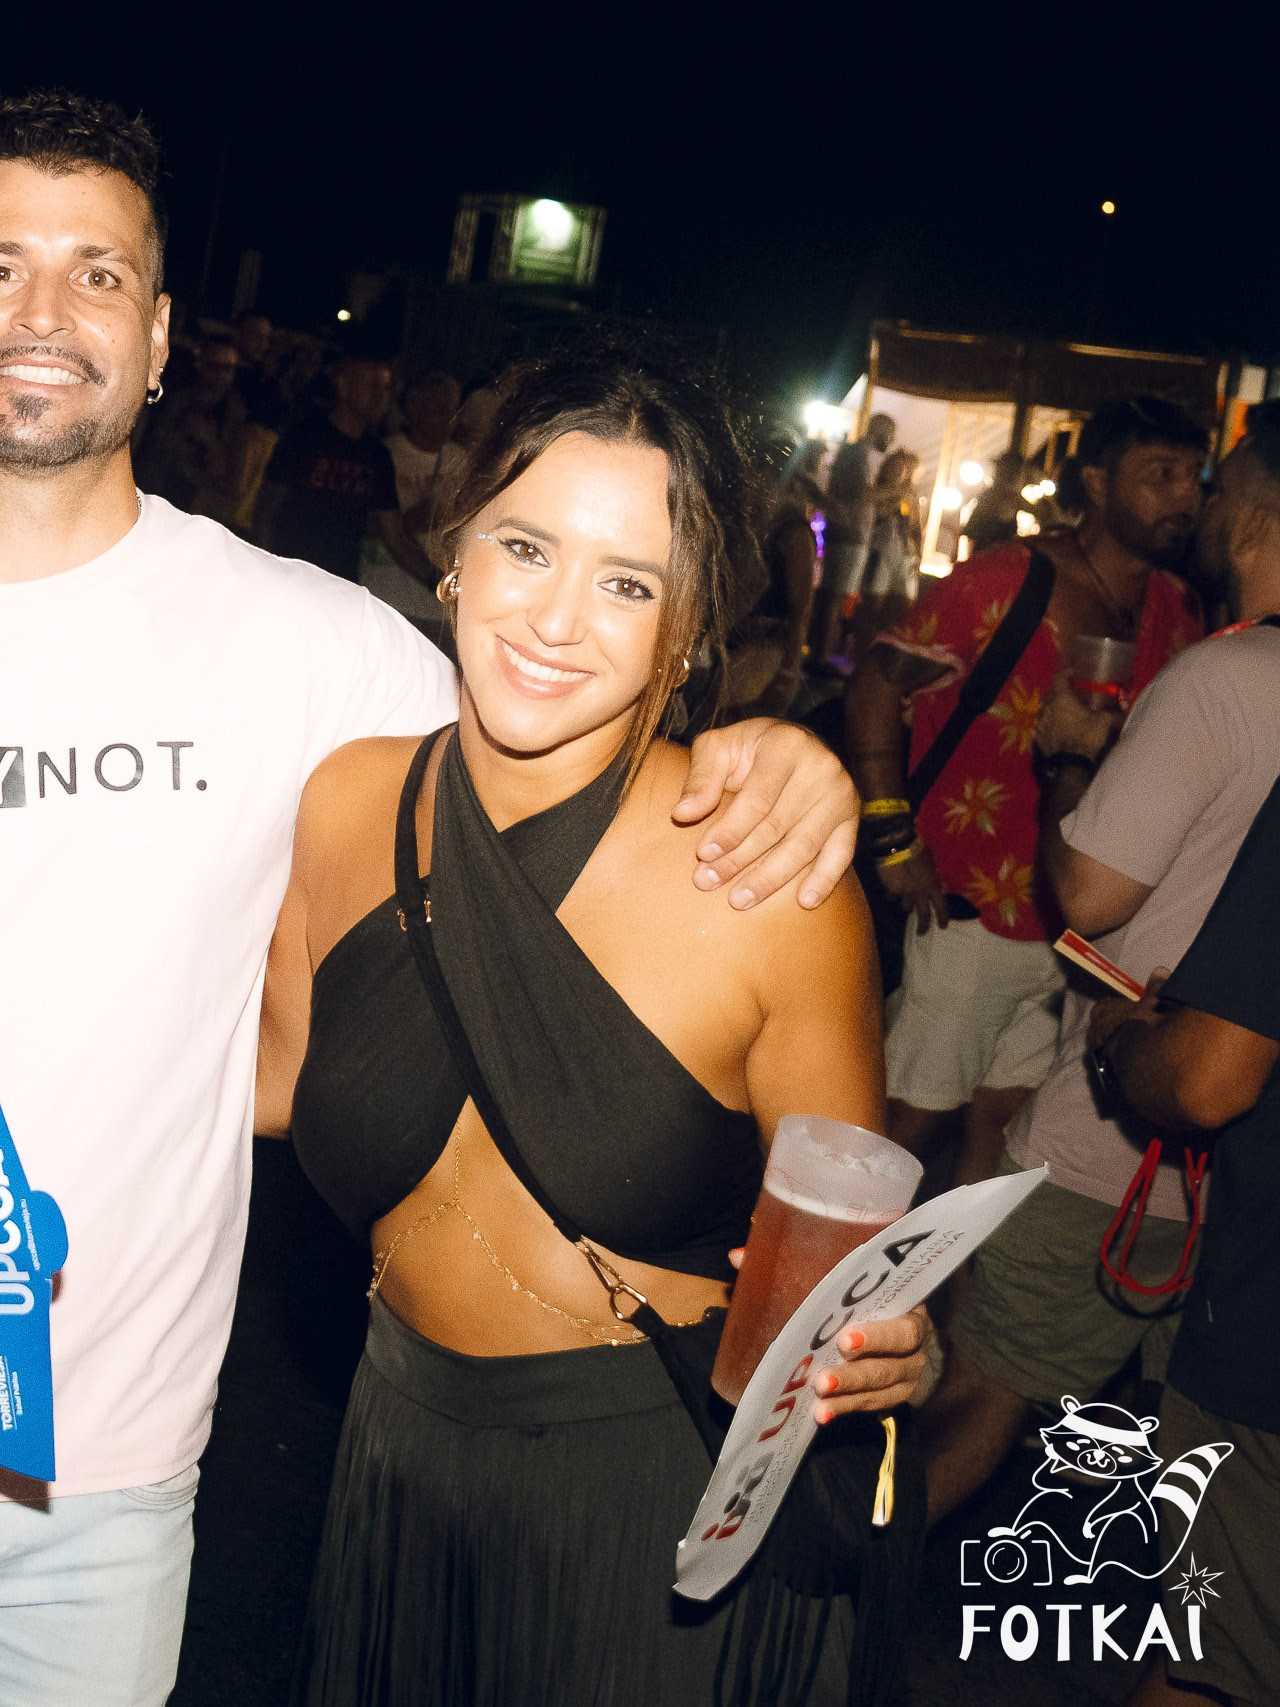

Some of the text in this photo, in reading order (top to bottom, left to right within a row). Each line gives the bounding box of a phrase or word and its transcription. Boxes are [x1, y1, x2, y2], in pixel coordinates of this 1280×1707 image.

[37, 741, 208, 799] NOT.
[875, 1230, 966, 1313] TORREVIEJA
[757, 1229, 936, 1444] UPCCA
